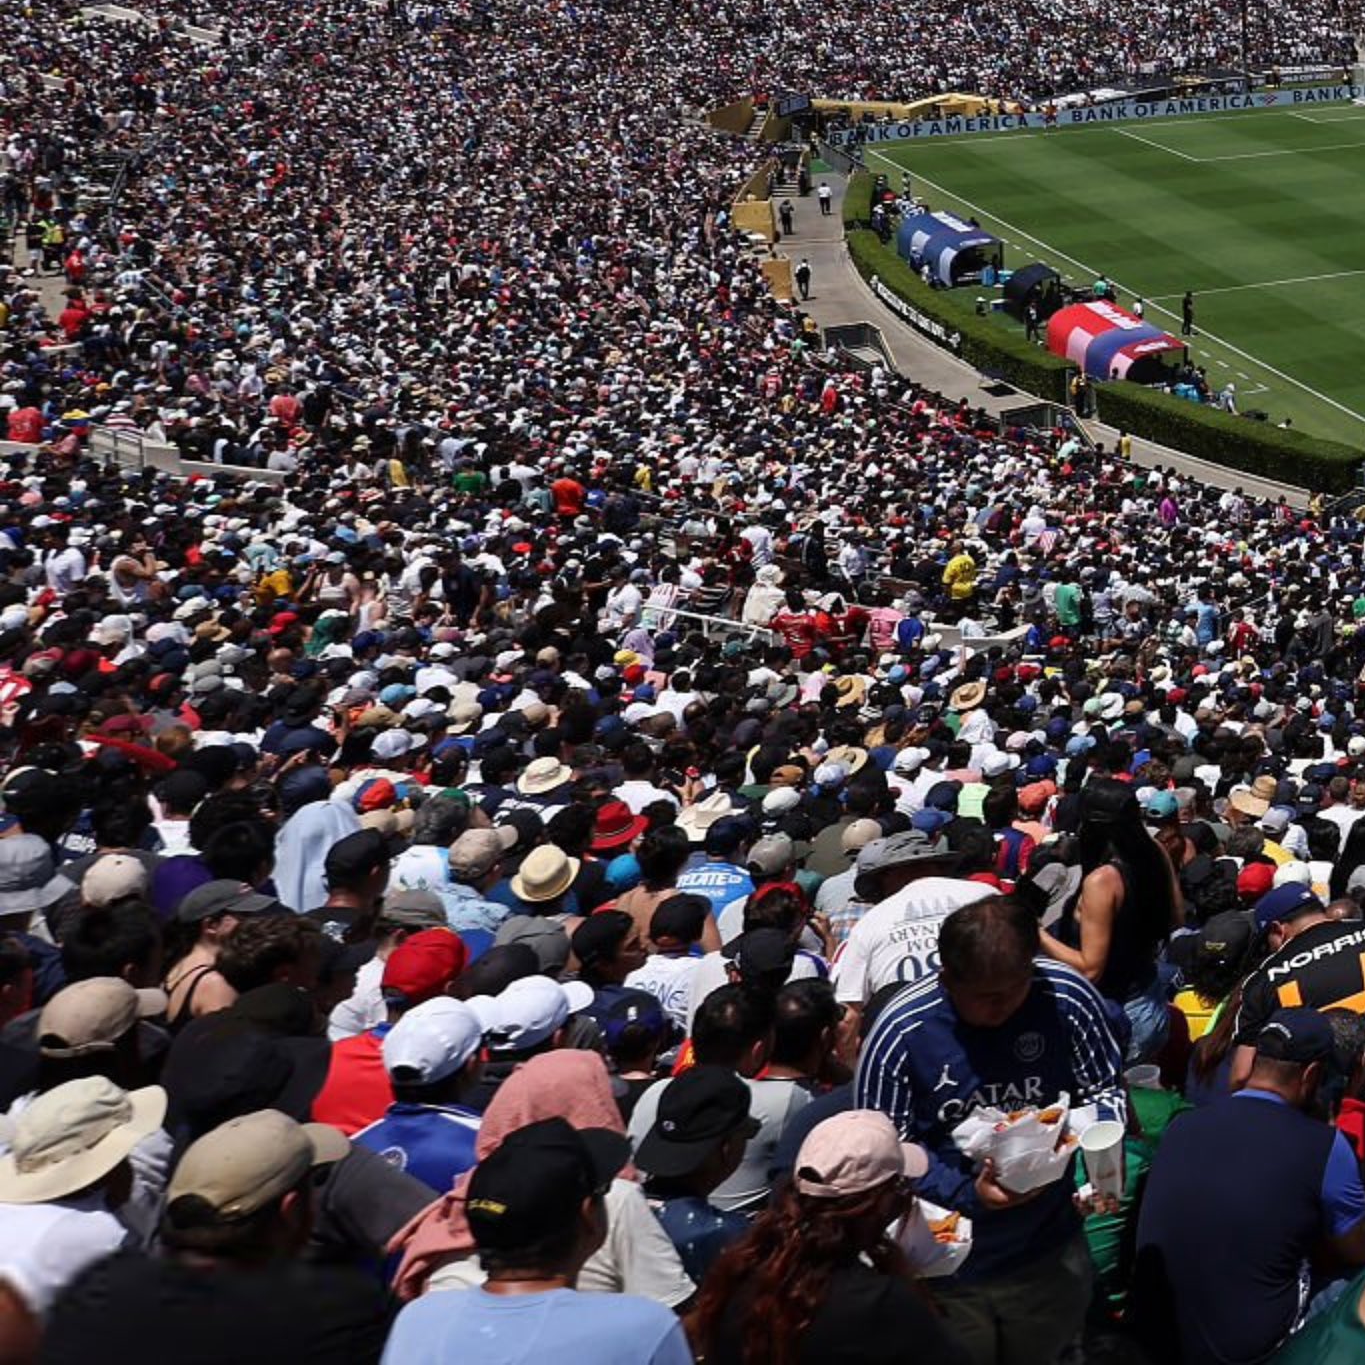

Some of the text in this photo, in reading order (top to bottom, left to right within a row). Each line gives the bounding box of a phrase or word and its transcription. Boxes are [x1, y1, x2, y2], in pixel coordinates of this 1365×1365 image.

[1293, 86, 1343, 102] BANK
[1072, 95, 1254, 122] BANK OF AMERICA
[896, 120, 923, 137] OF
[929, 113, 1028, 134] AMERICA
[938, 1076, 1044, 1122] QATAR
